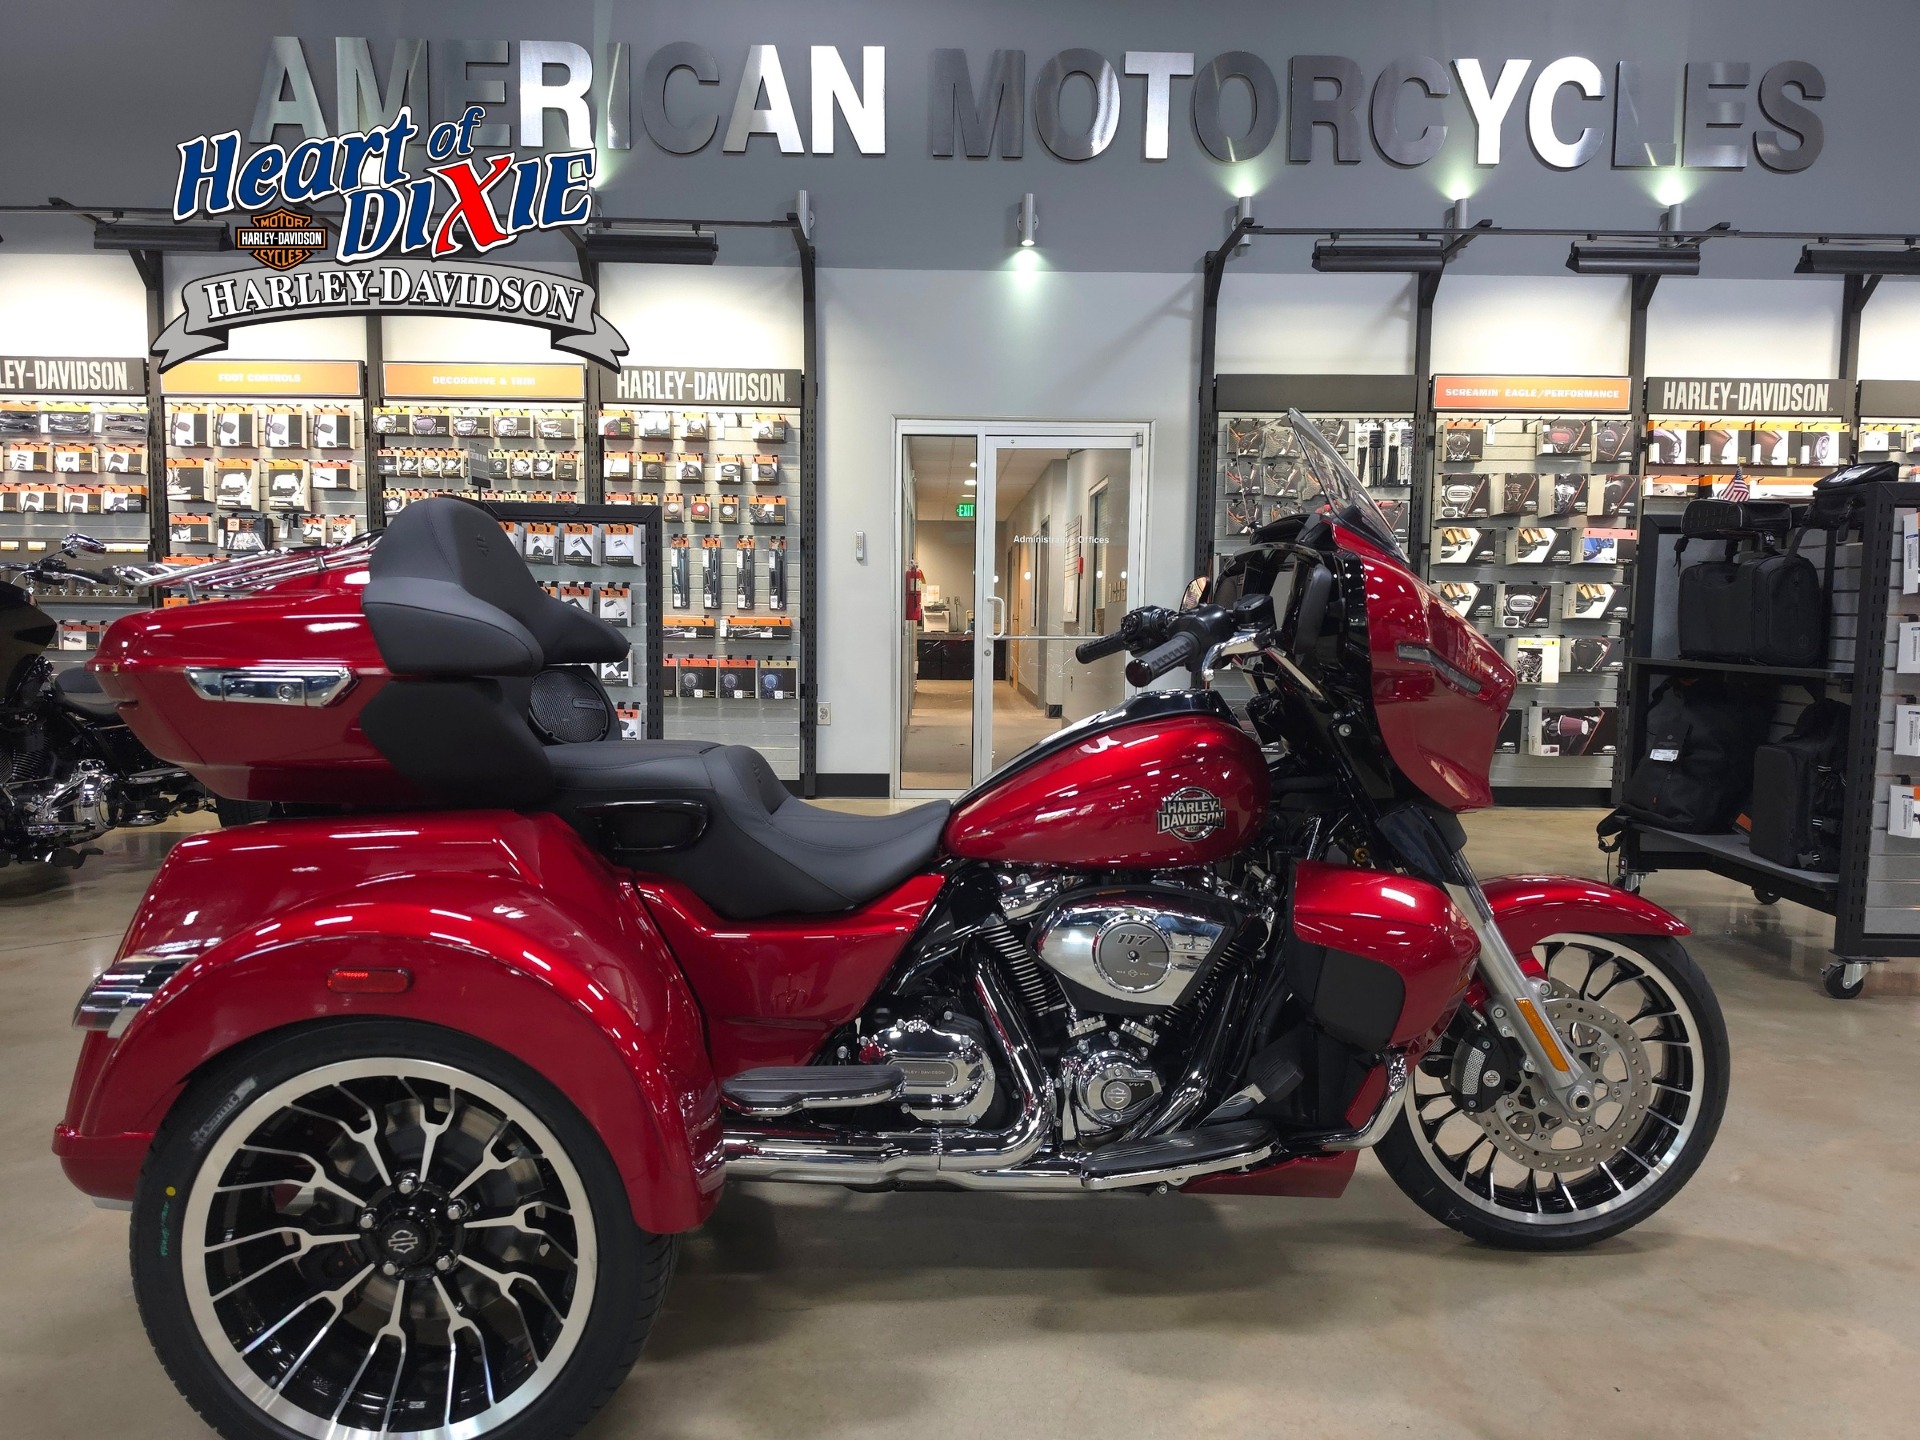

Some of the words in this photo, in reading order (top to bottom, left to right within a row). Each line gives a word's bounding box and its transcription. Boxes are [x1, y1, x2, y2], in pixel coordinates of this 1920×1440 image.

[249, 36, 886, 154] AMERICAN
[932, 47, 1826, 172] MOTORCYCLES
[218, 373, 244, 383] FOOT
[247, 373, 302, 383] CONTROLS
[432, 376, 496, 385] DECORATIVE
[511, 377, 536, 386] TRIM
[616, 369, 786, 402] HARLEY-DAVIDSON
[1662, 380, 1830, 412] HARLEY-DAVIDSON
[958, 504, 975, 517] EXIT
[1078, 534, 1110, 544] Offices
[1161, 811, 1224, 830] DAVIDSON
[1117, 933, 1154, 946] 117
